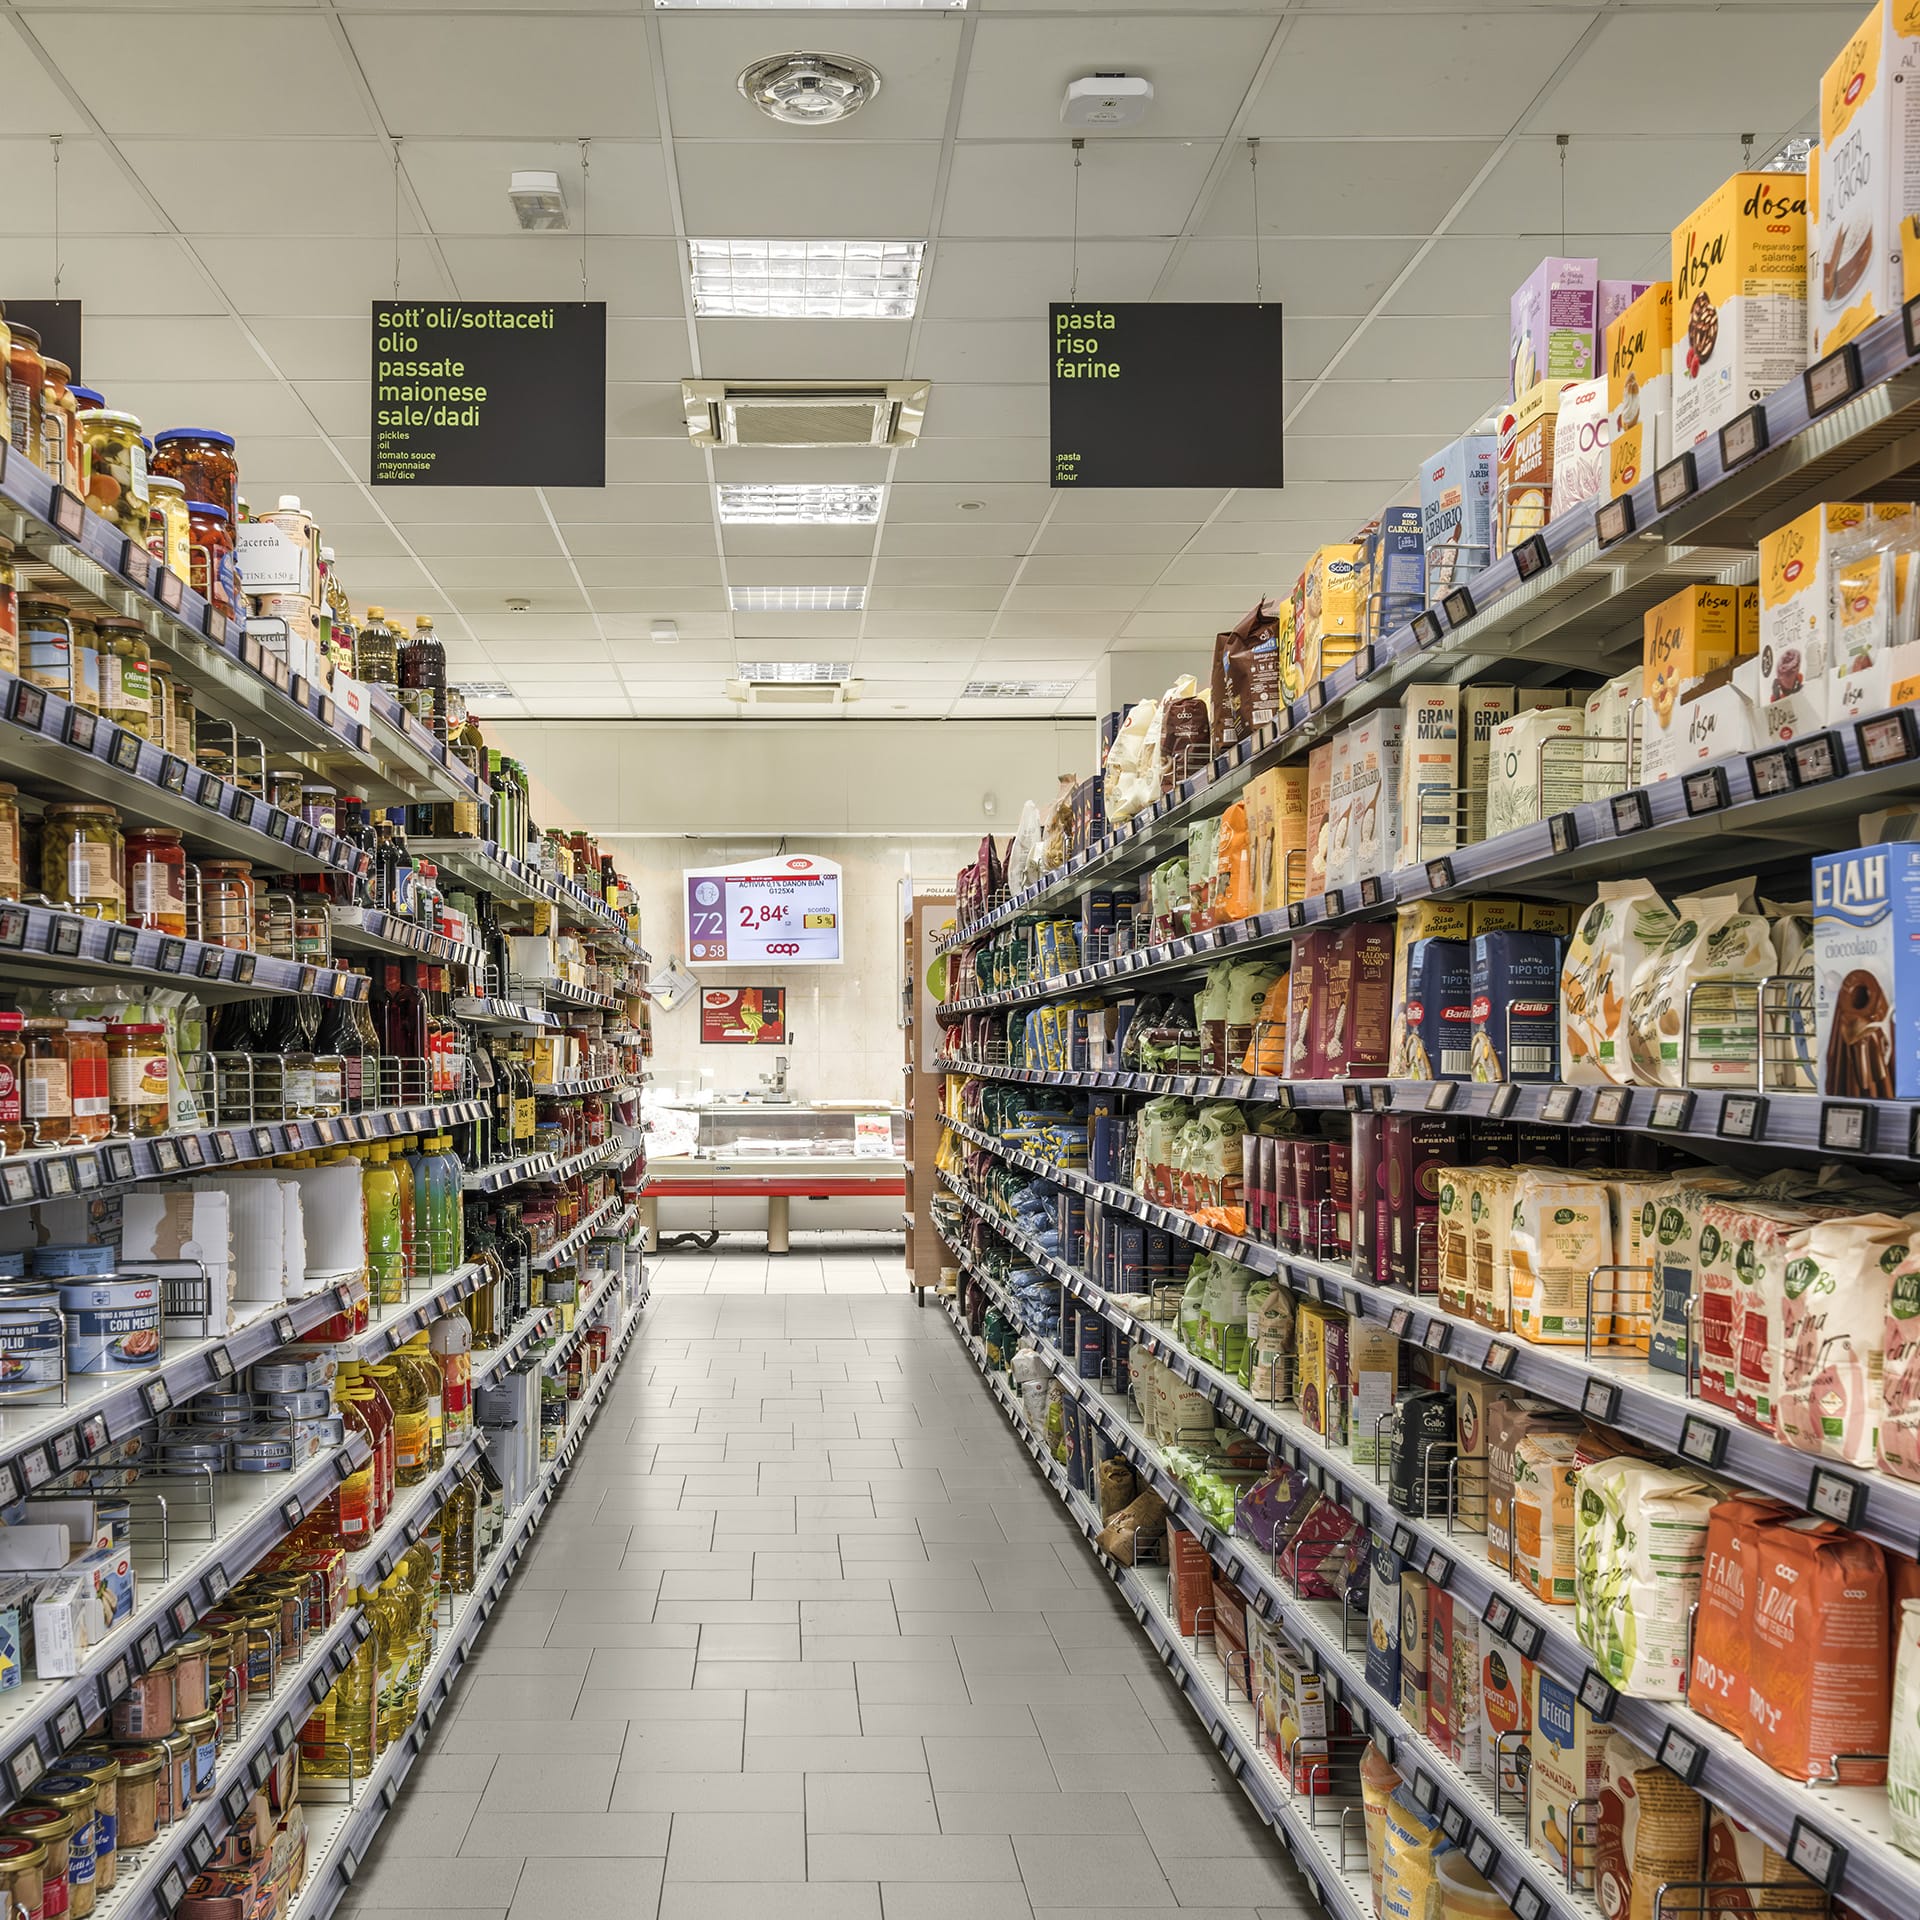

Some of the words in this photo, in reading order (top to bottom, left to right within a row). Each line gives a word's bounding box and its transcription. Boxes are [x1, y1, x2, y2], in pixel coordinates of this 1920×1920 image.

[1744, 183, 1807, 219] d'osa
[1766, 224, 1791, 235] coop
[1752, 242, 1790, 252] Preparato
[1792, 244, 1806, 254] per
[1761, 253, 1797, 262] salame
[1678, 230, 1731, 300] d'osa
[1748, 263, 1757, 272] al
[1056, 311, 1116, 335] pasta
[378, 332, 418, 352] olio
[1056, 333, 1099, 354] riso
[1613, 325, 1647, 379] d'osa
[378, 358, 465, 382] passate
[1056, 358, 1121, 378] farine
[378, 382, 488, 402] maionese
[1576, 391, 1596, 405] coop
[377, 406, 480, 426] sale/dadi
[1432, 467, 1446, 482] coop
[1425, 500, 1440, 521] RISO
[1387, 525, 1423, 534] CARNARO
[1425, 506, 1463, 543] ARBORIO
[1697, 590, 1732, 609] d'osa
[1649, 616, 1685, 668] d'osa
[1418, 709, 1453, 724] GRAN
[1474, 711, 1509, 727] GRAN
[1498, 726, 1514, 735] coop
[1688, 703, 1718, 745] d'osa
[1418, 725, 1443, 739] MIX
[1474, 727, 1491, 741] MI
[1815, 855, 1888, 908] ELAH
[693, 912, 724, 935] 72
[817, 916, 823, 924] 5
[1432, 916, 1453, 925] Riso
[1483, 915, 1505, 924] Riso
[1533, 919, 1554, 928] Riso
[1425, 922, 1464, 933] Integrale
[708, 945, 725, 957] 58
[766, 943, 800, 956] coop
[1824, 935, 1878, 959] cioccolato
[1356, 952, 1390, 960] VIALONE
[1362, 958, 1384, 966] NANO
[1508, 966, 1532, 975] TIPO
[1441, 976, 1463, 985] TIPO
[1445, 1009, 1471, 1018] Barill
[1513, 1002, 1549, 1012] Barilla
[1412, 1135, 1455, 1145] Carnaroli
[1472, 1134, 1513, 1142] Carnaroli
[1520, 1134, 1561, 1142] Carnaroli
[1570, 1135, 1611, 1143] Carnaroli
[134, 1289, 152, 1299] coop
[110, 1319, 132, 1332] CON
[1424, 1418, 1446, 1428] Gallo
[1707, 1551, 1745, 1598] FARINA
[1843, 1589, 1868, 1600] coop
[1697, 1655, 1717, 1688] TIPO
[1717, 1673, 1735, 1697] "2"
[1541, 1697, 1551, 1720] DE
[1550, 1703, 1571, 1732] CECCO
[1750, 1687, 1767, 1722] TIPO
[1767, 1708, 1783, 1733] "2"
[1535, 1760, 1577, 1797] IMPANATURA
